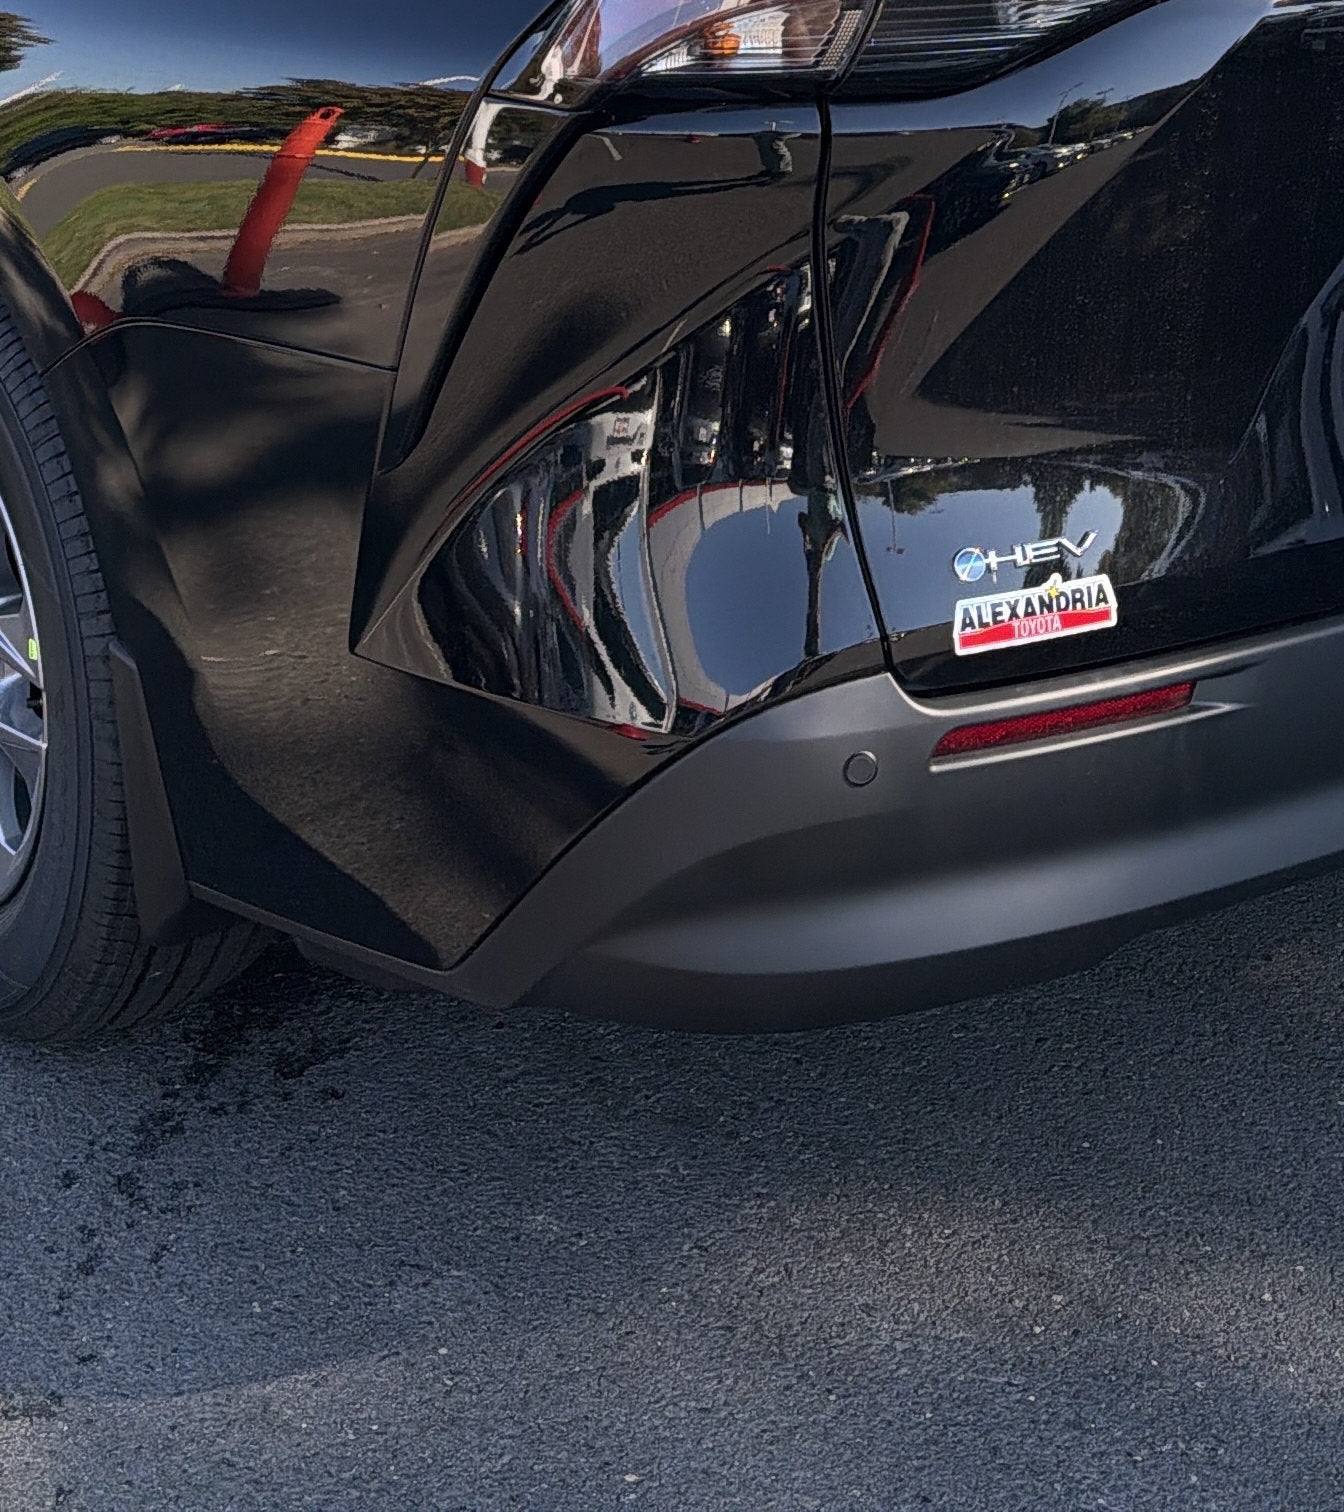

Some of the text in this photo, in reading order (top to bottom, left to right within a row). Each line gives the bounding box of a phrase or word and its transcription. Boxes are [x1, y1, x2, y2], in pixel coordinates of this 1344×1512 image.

[987, 529, 1099, 571] HEV
[960, 582, 1110, 633] ALEXANDRIA
[1012, 615, 1063, 639] TOYOTA
